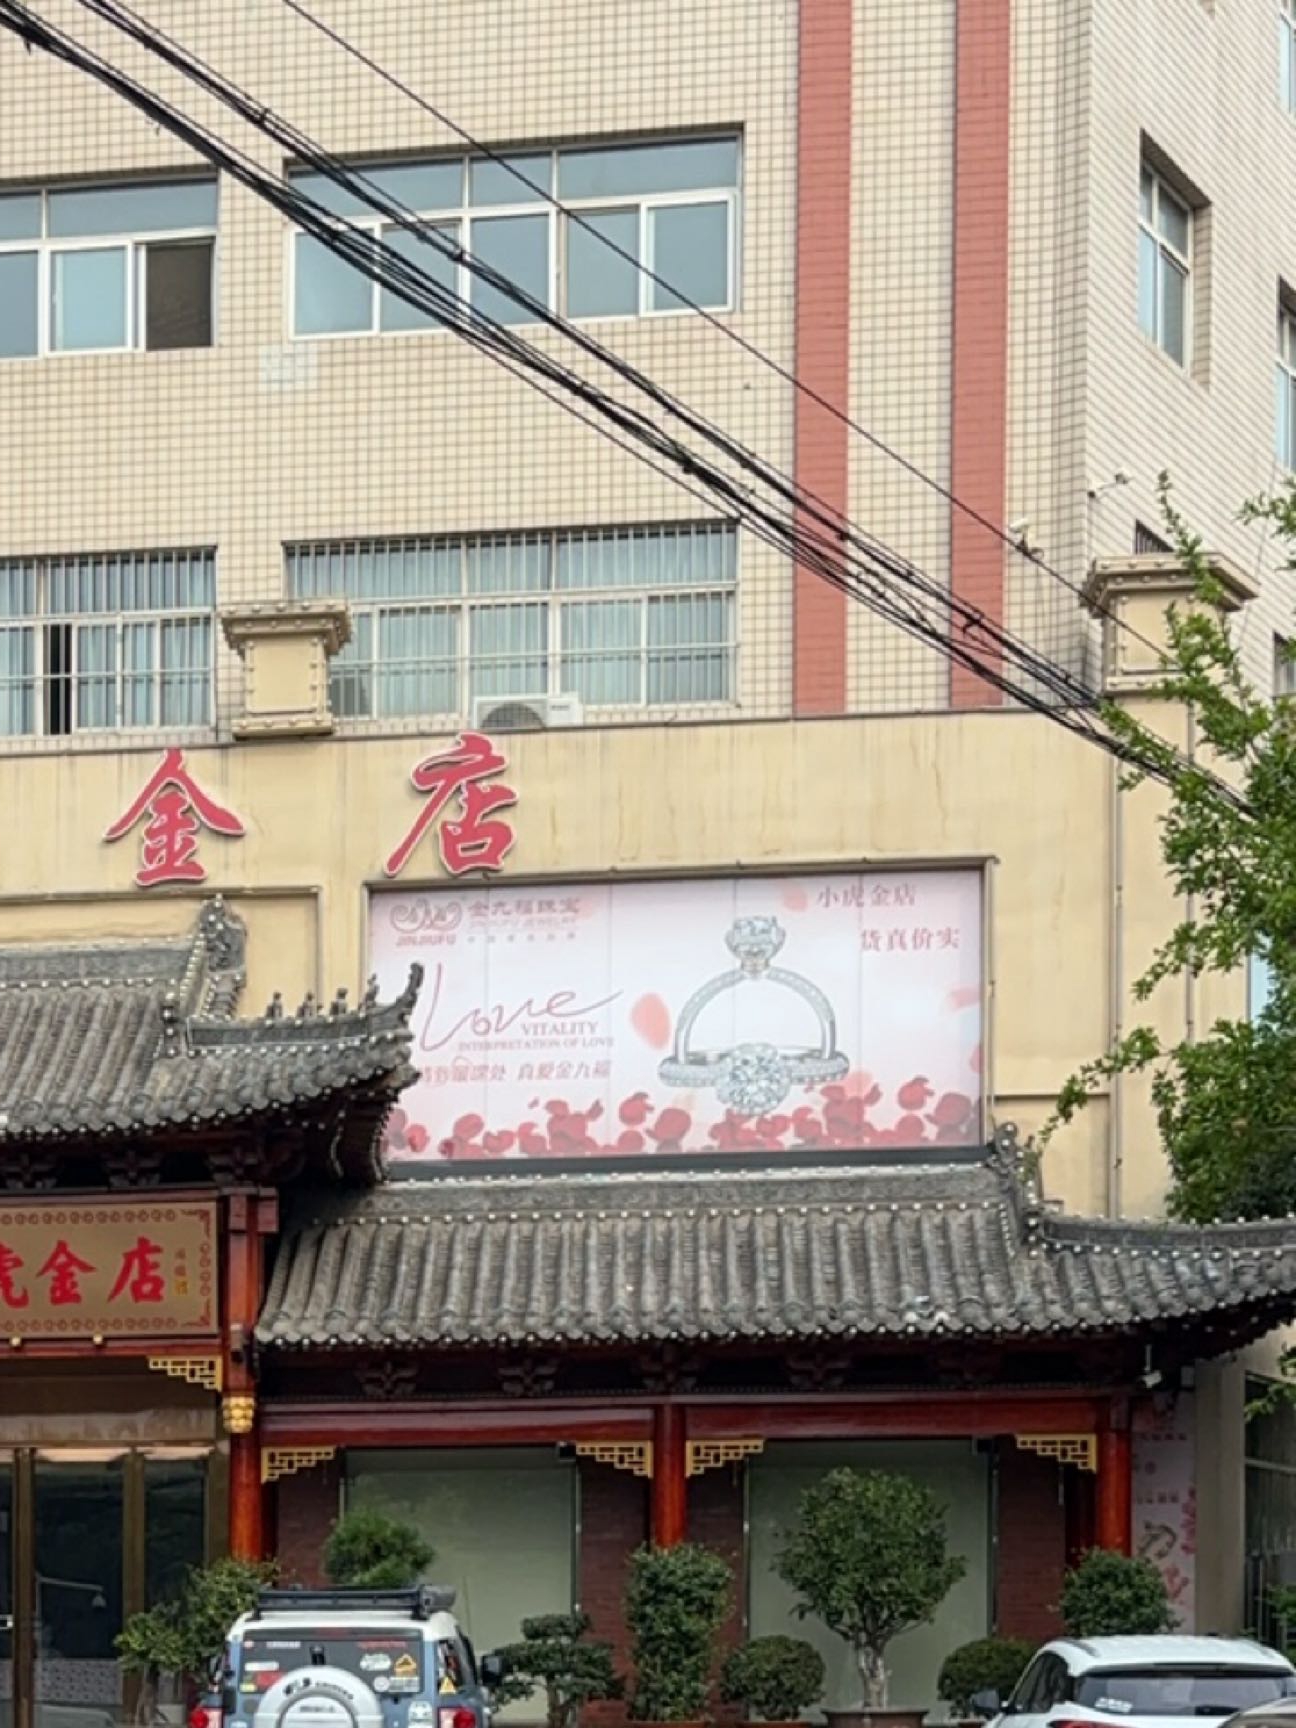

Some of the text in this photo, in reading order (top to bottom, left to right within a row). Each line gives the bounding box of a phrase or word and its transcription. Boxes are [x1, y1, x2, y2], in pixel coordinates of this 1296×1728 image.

[817, 882, 918, 908] 小虎金店
[861, 926, 961, 952] 货真价实
[420, 962, 623, 1052] Love
[520, 1022, 599, 1037] VITALITY
